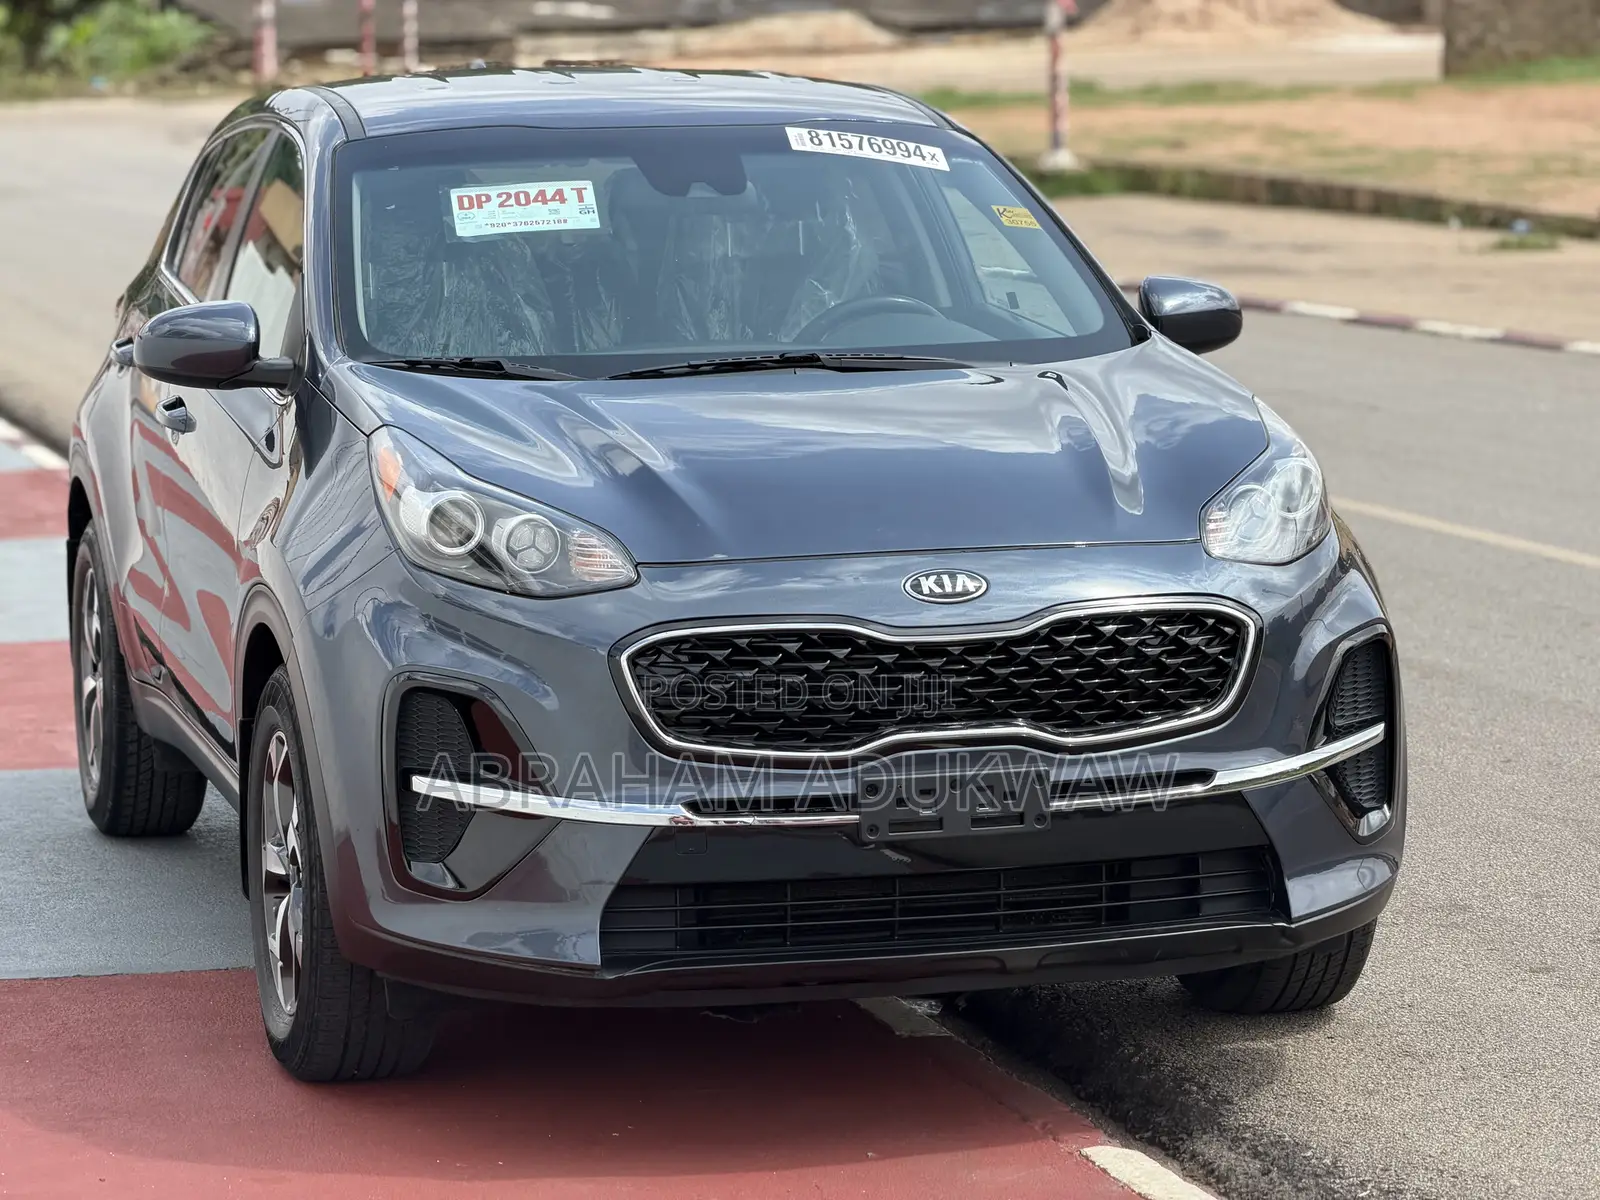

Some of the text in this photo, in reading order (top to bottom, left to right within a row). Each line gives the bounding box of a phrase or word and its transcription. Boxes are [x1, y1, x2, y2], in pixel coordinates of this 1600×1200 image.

[807, 130, 926, 162] 81576994
[456, 187, 588, 211] DP 2044 T
[918, 574, 976, 595] KIA
